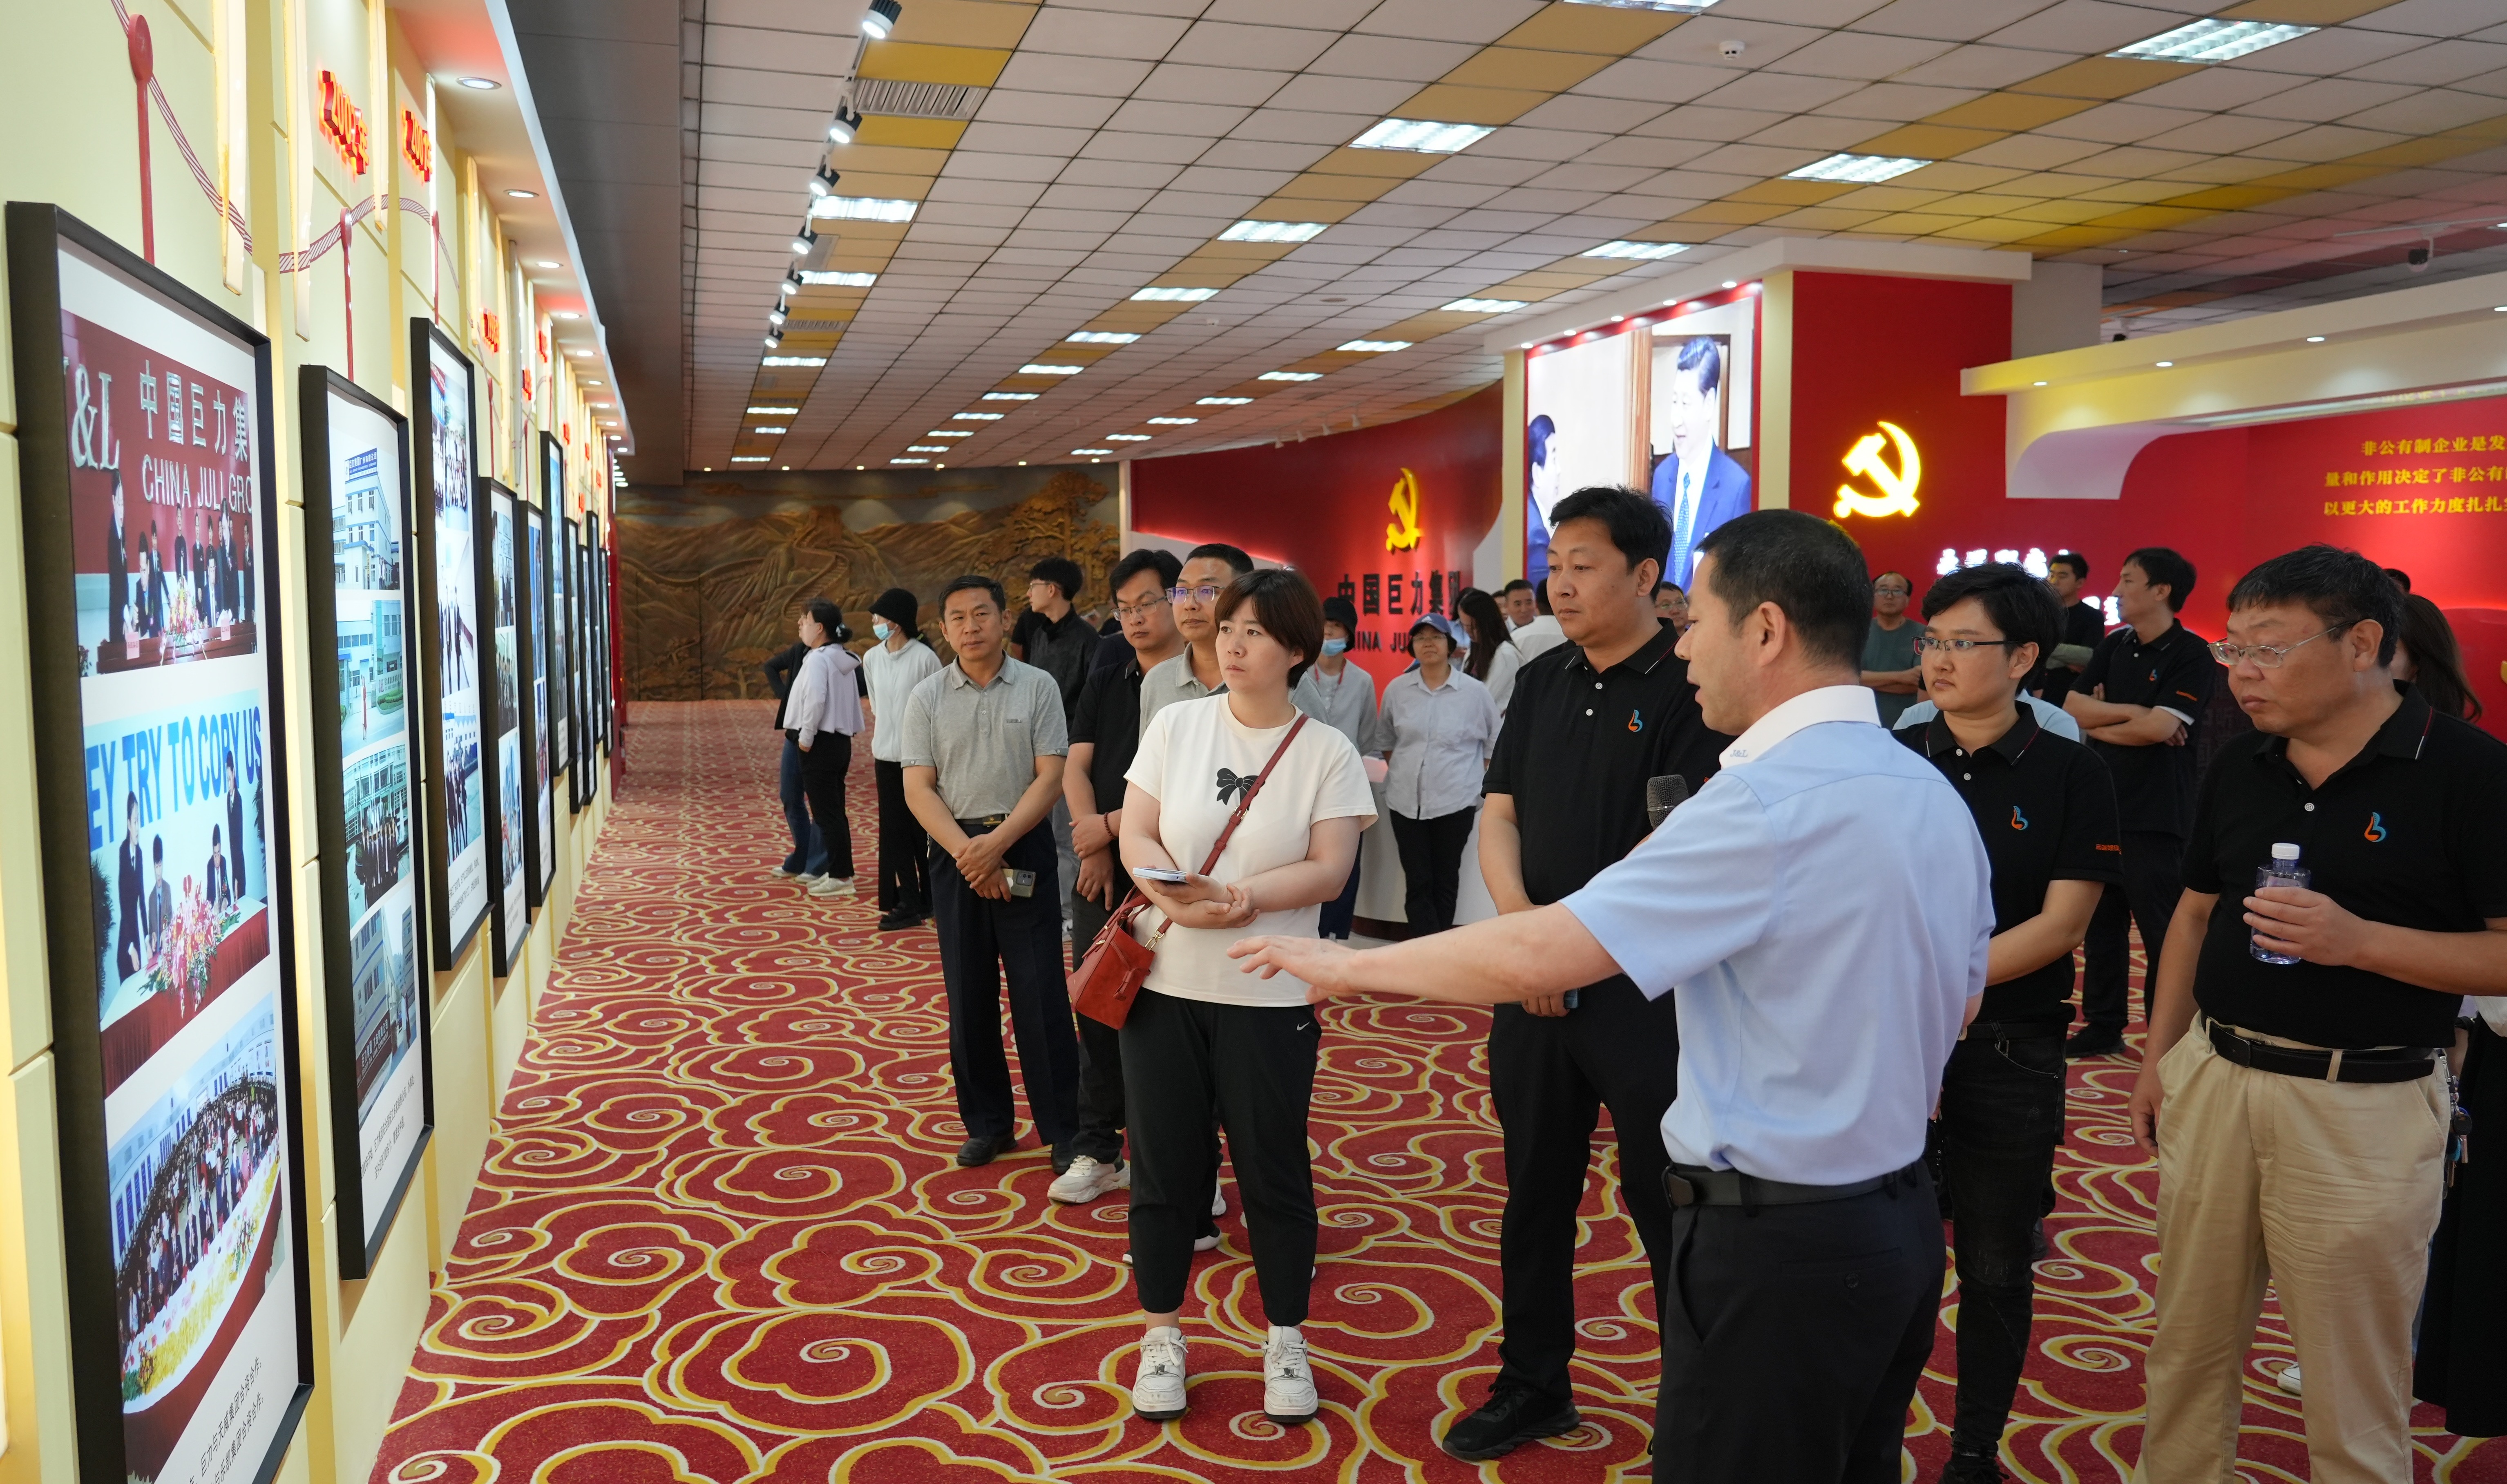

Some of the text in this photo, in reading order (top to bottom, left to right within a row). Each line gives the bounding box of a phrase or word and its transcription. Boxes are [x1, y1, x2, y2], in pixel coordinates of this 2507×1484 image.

[63, 356, 120, 470] &L
[139, 360, 248, 462] 中国巨力集
[2361, 435, 2506, 456] 非公有制企业是发
[142, 454, 191, 508] CHINA
[197, 466, 224, 511] JULI
[2324, 465, 2507, 487] 量和作用决定了非公有
[2324, 496, 2507, 516] 以更大的工作力度扎扎
[1356, 631, 1409, 653] INA JU
[122, 726, 162, 828] TRY
[168, 716, 194, 812] TO
[198, 712, 240, 801] COPY
[243, 706, 262, 784] US
